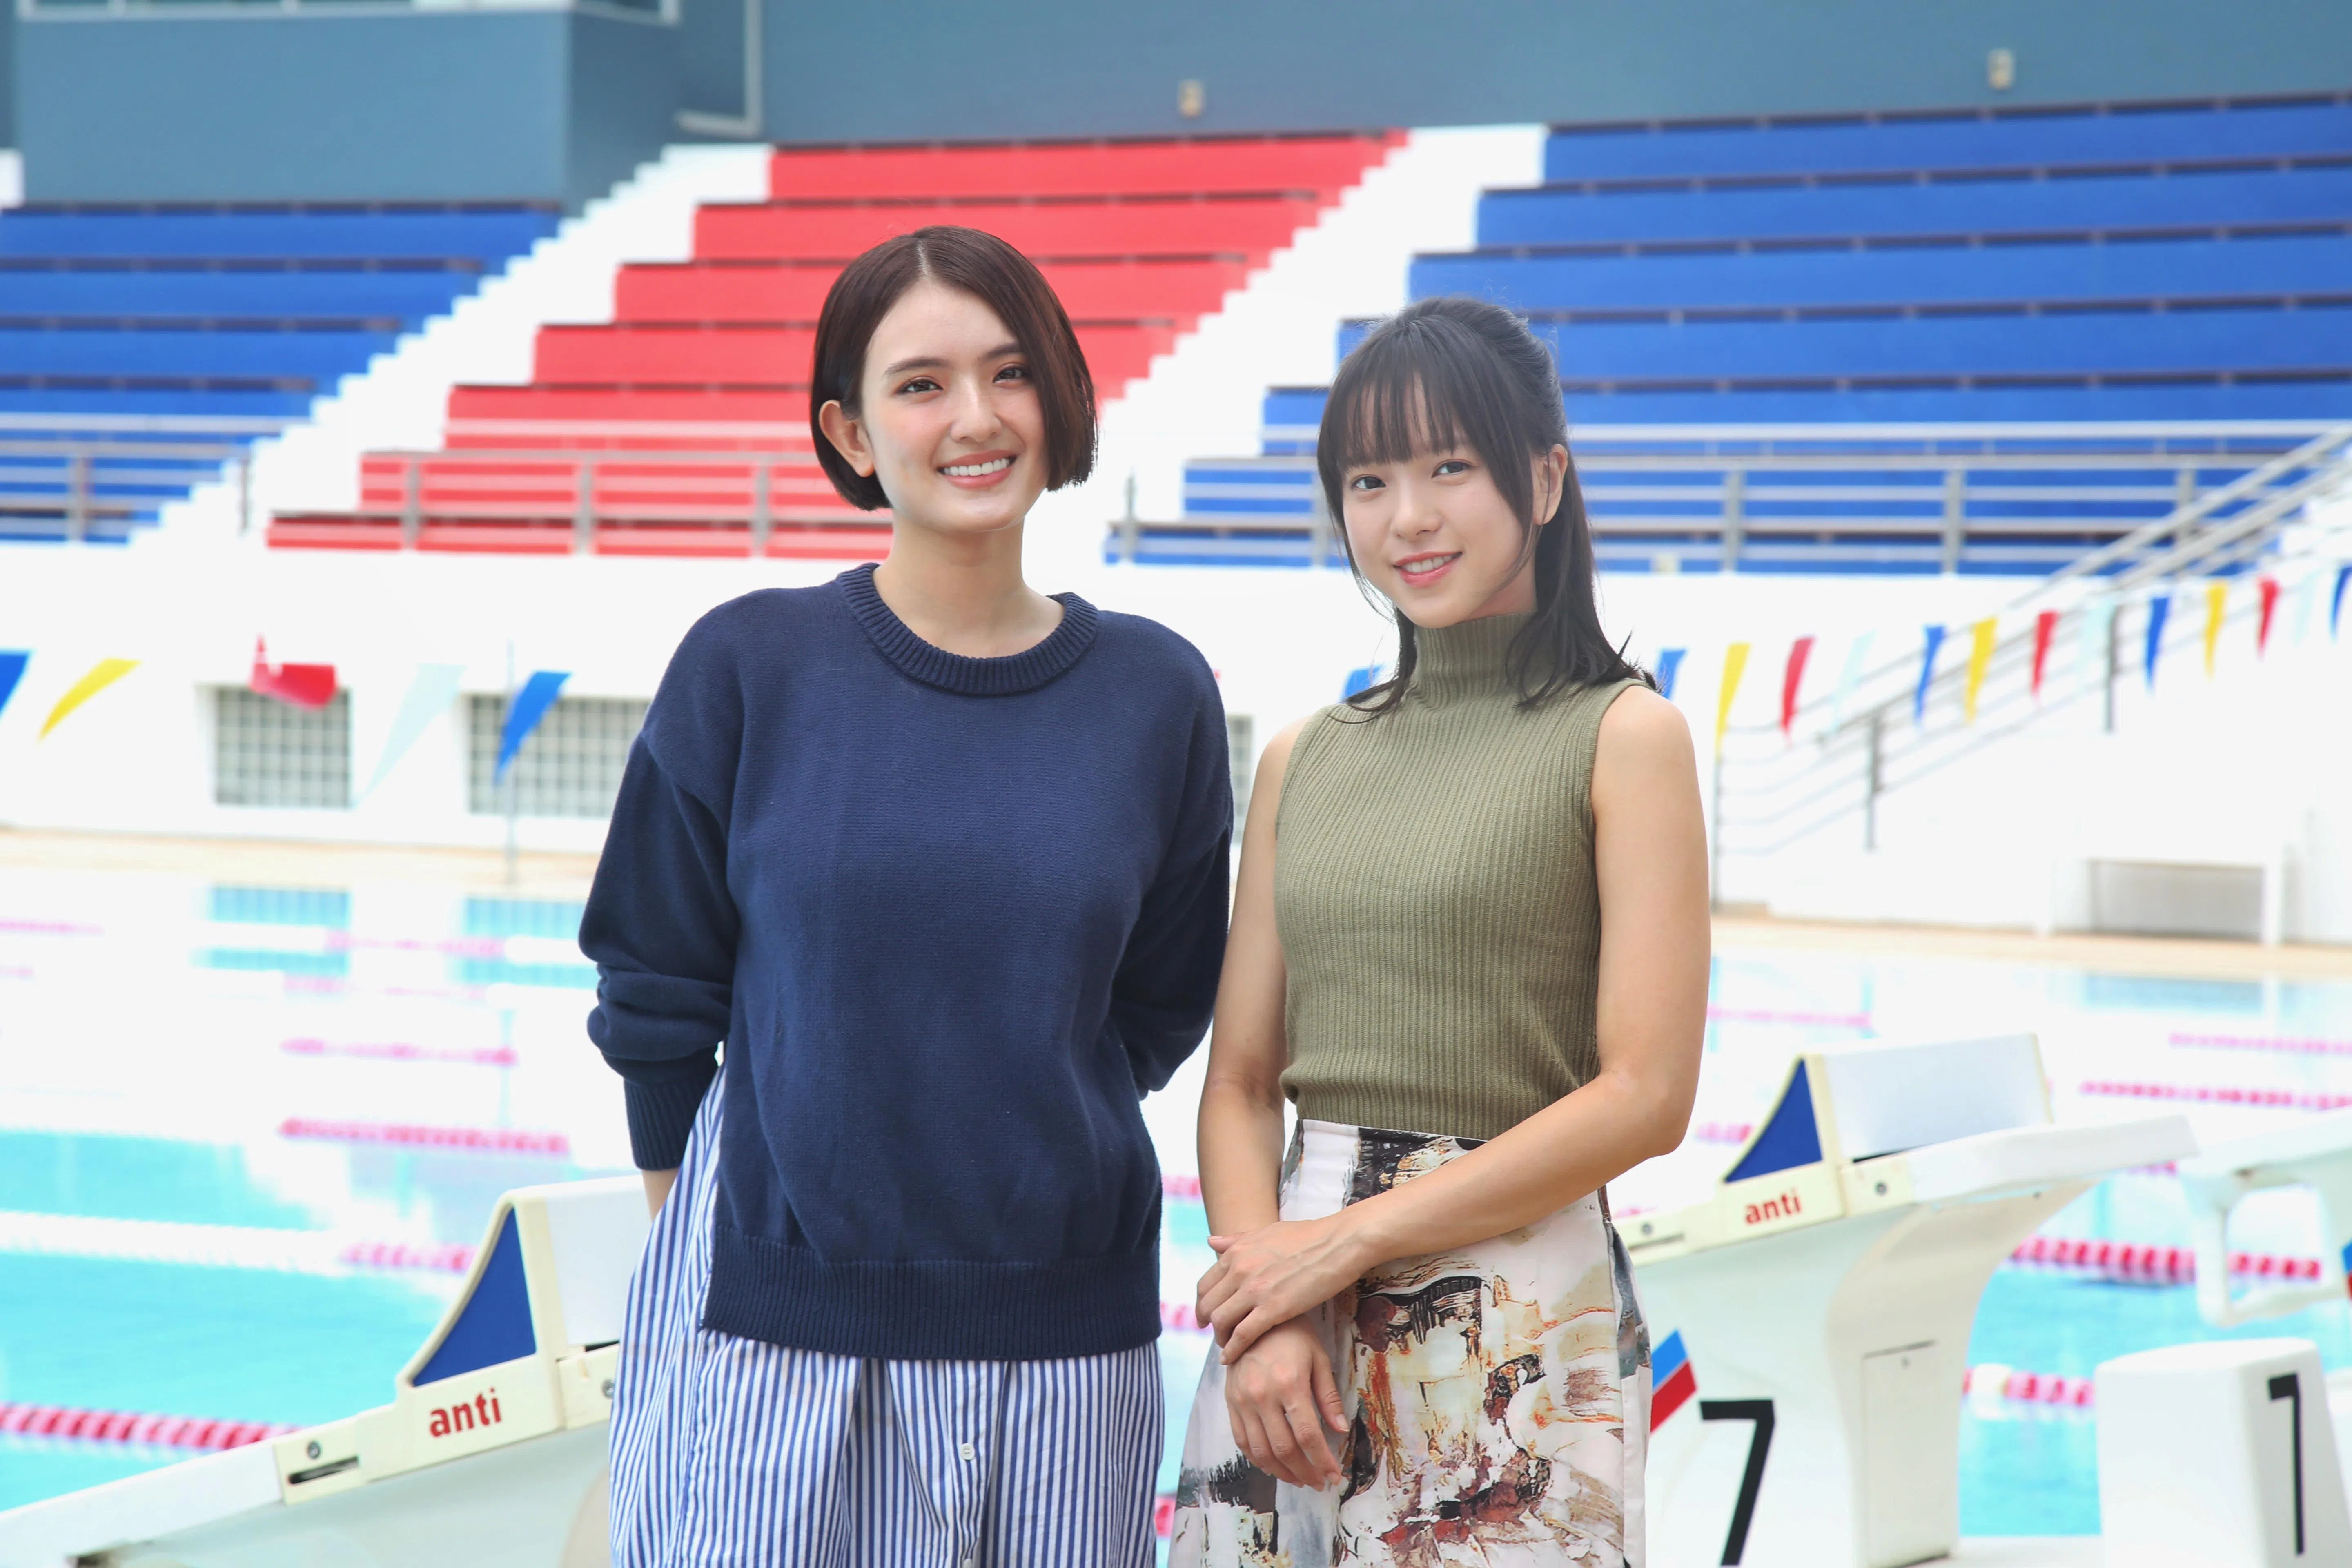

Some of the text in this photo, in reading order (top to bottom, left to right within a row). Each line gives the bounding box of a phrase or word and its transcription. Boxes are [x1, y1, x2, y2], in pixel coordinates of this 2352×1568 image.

[1746, 1188, 1801, 1224] anti
[430, 1387, 501, 1437] anti
[1700, 1399, 1775, 1566] 7
